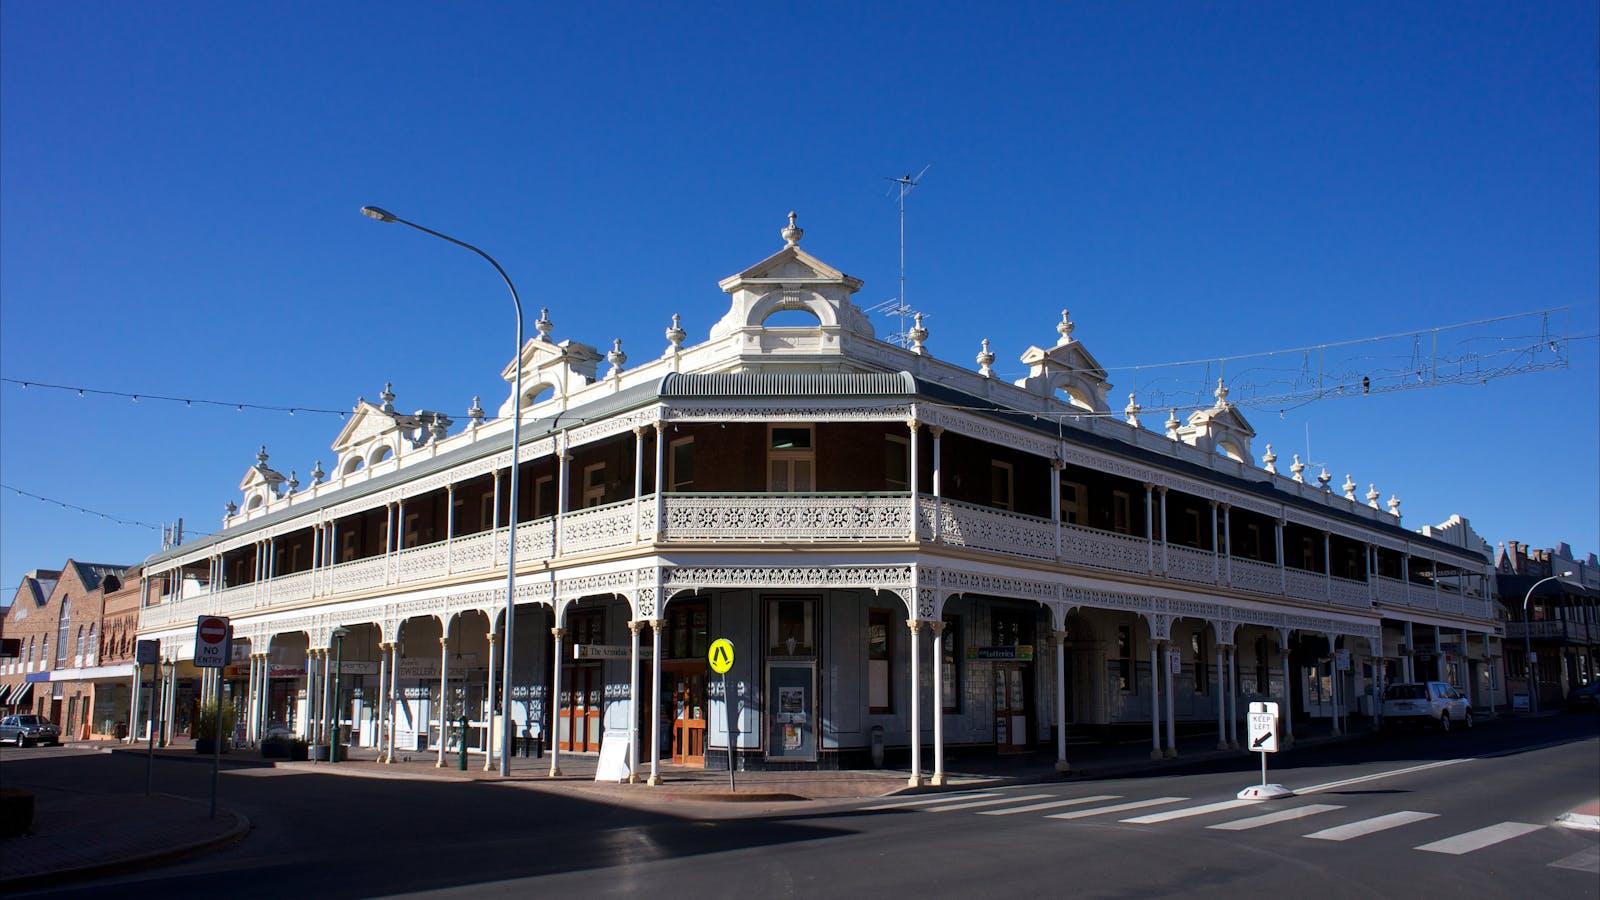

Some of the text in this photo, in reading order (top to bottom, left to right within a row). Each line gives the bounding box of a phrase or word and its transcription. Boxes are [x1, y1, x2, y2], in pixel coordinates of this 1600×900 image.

[204, 646, 219, 655] NO
[590, 647, 602, 656] The
[197, 656, 223, 665] ENTRY
[1253, 715, 1271, 723] KEEP
[1254, 723, 1270, 731] LEFT
